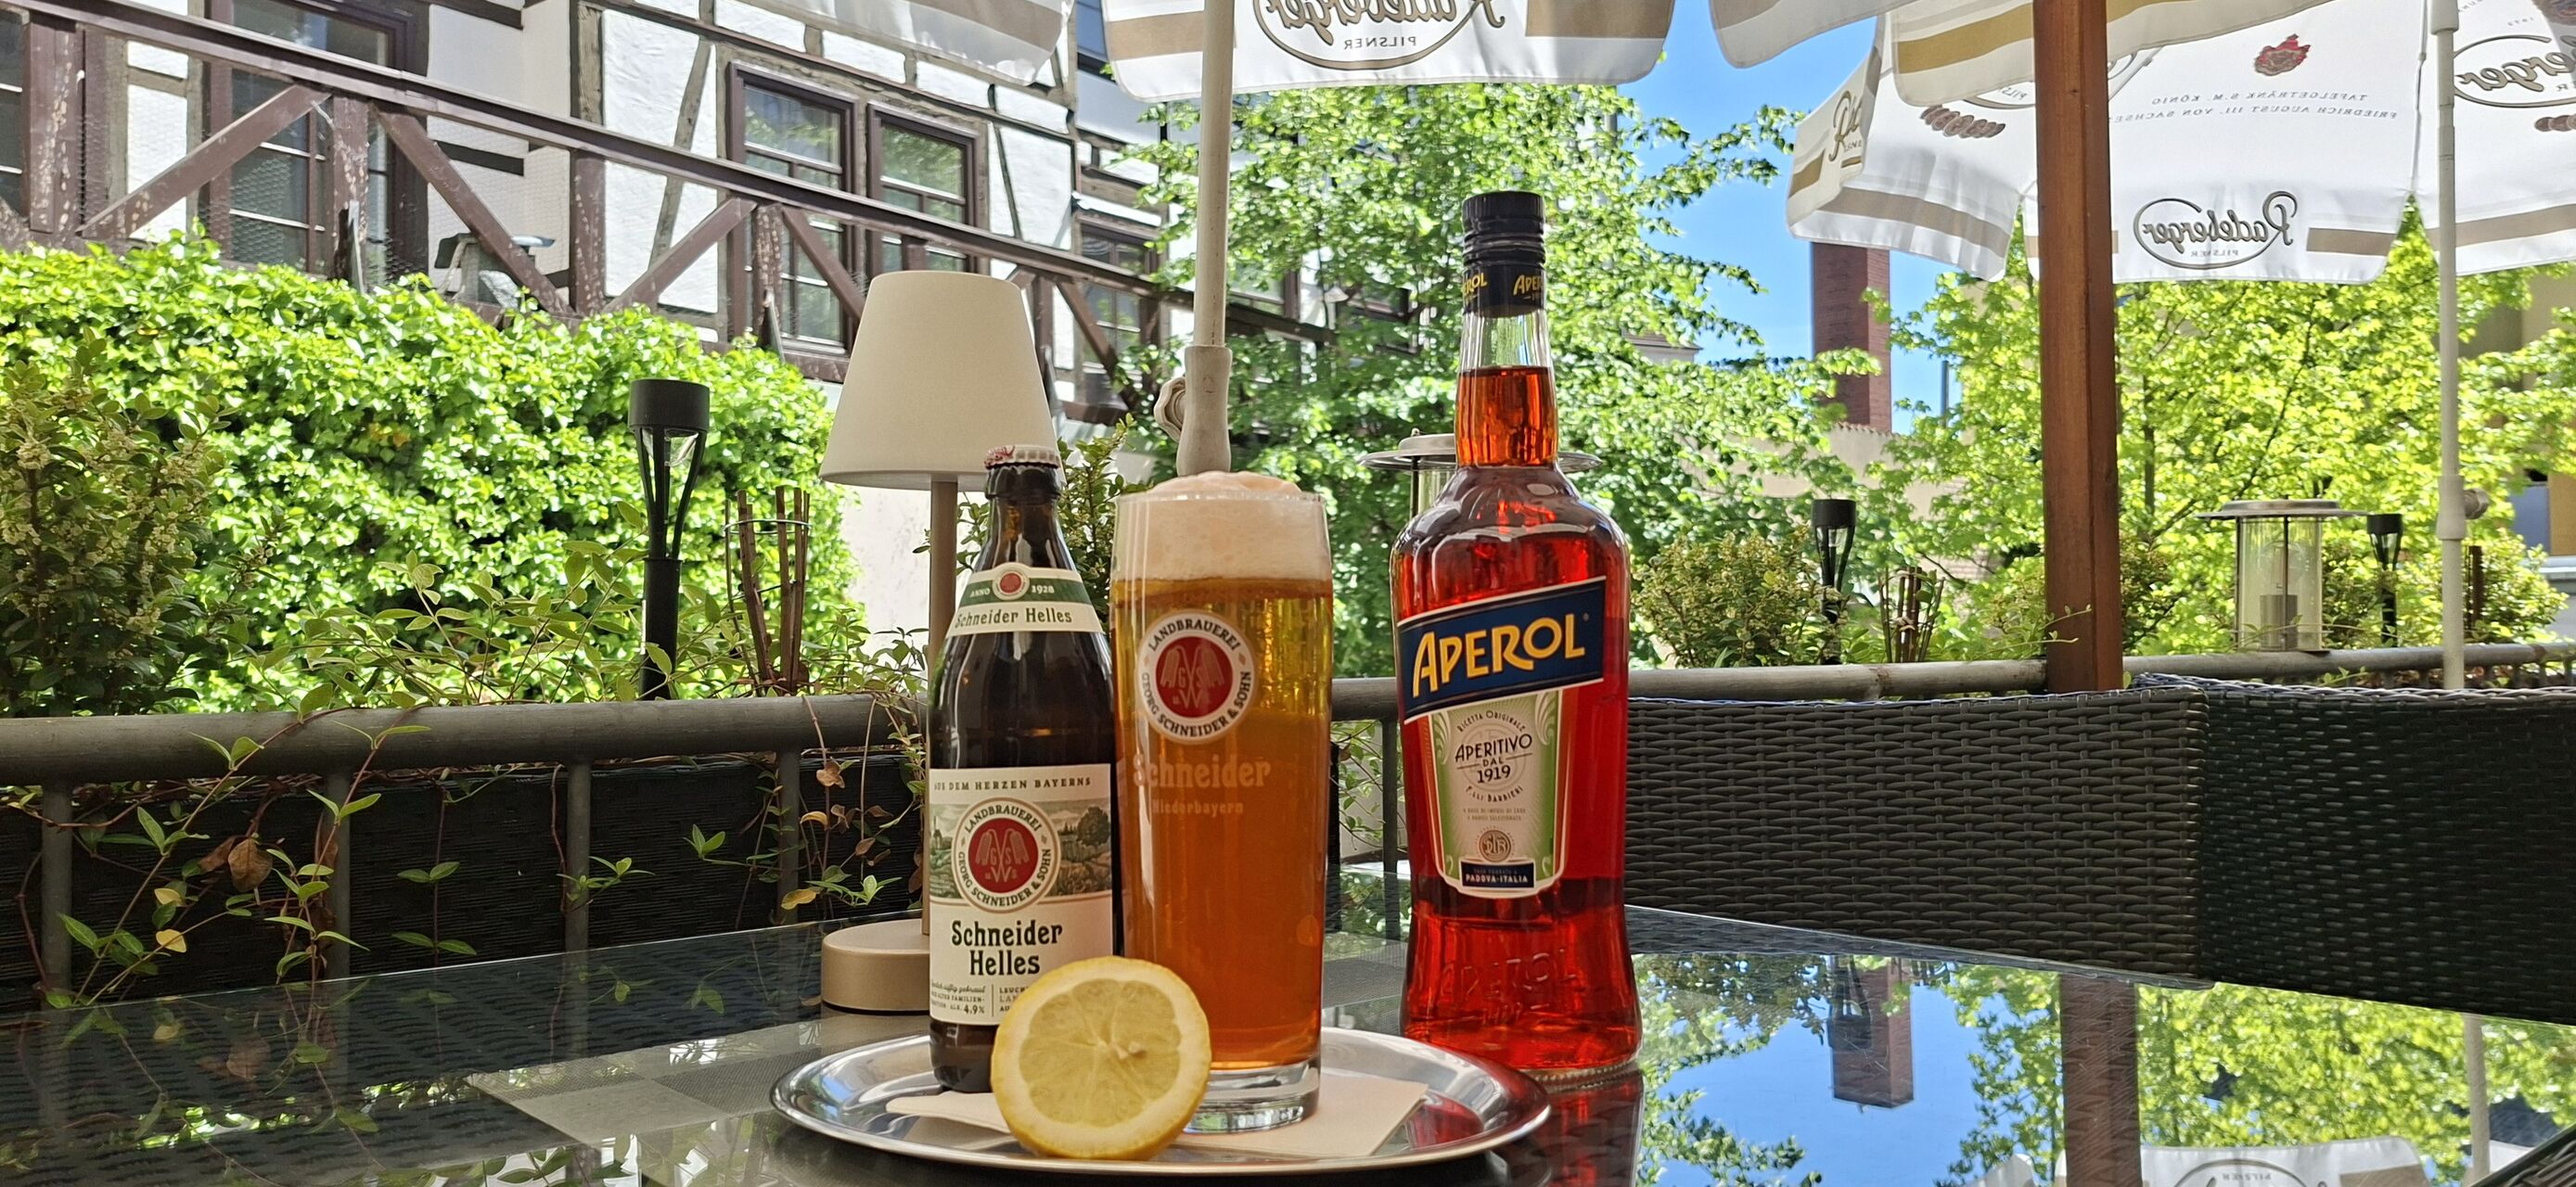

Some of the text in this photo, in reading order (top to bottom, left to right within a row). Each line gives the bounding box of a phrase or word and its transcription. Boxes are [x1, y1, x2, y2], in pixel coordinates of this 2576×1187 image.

[955, 607, 1072, 629] Schneider Helles
[1148, 619, 1241, 652] LANDBRAUEREI
[1413, 613, 1585, 698] APEROL
[1159, 714, 1228, 737] SCHNEIDER
[1235, 670, 1251, 709] SOHN
[1455, 734, 1532, 762] APERITIVO
[1482, 757, 1504, 767] DAL
[949, 782, 969, 790] DEM
[975, 780, 1028, 790] HERZEN
[1034, 777, 1091, 788] BAYERNS
[1134, 753, 1272, 787] Schneider
[1477, 764, 1511, 784] 1919
[965, 805, 1042, 834] LANDBRAUEREI
[958, 851, 973, 888] GEORG
[971, 888, 1032, 907] SCHNEIDER
[1036, 848, 1052, 881] SOHN
[952, 920, 1063, 946] Schneider
[969, 949, 1041, 976] Helles
